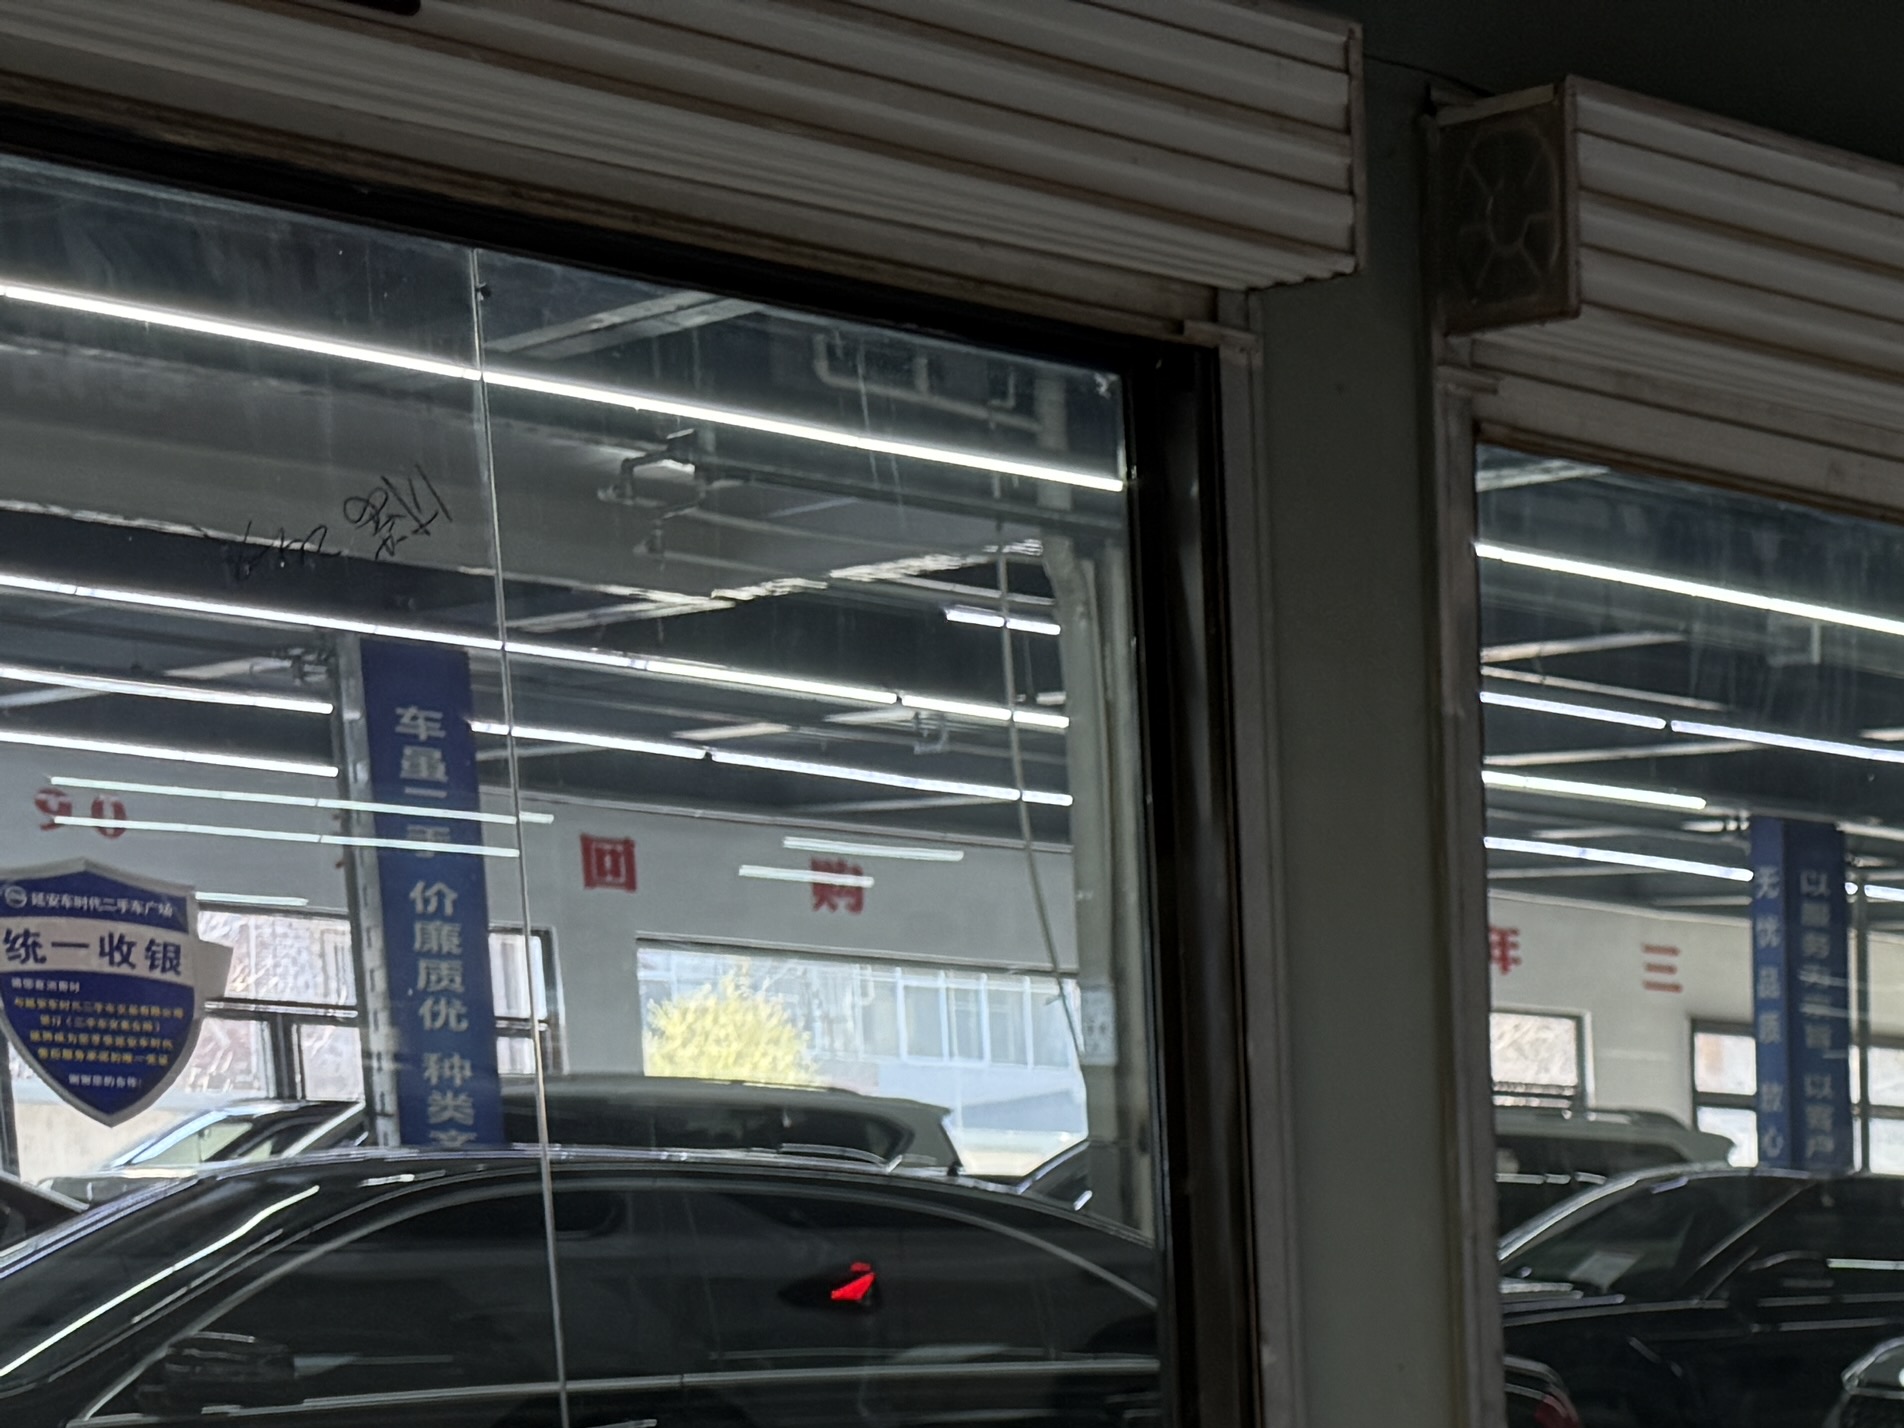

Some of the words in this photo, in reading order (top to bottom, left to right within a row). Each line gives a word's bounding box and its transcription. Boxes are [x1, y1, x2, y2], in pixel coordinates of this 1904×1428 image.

[3, 928, 183, 976] 统一收银
[408, 879, 470, 1034] 价廉质优
